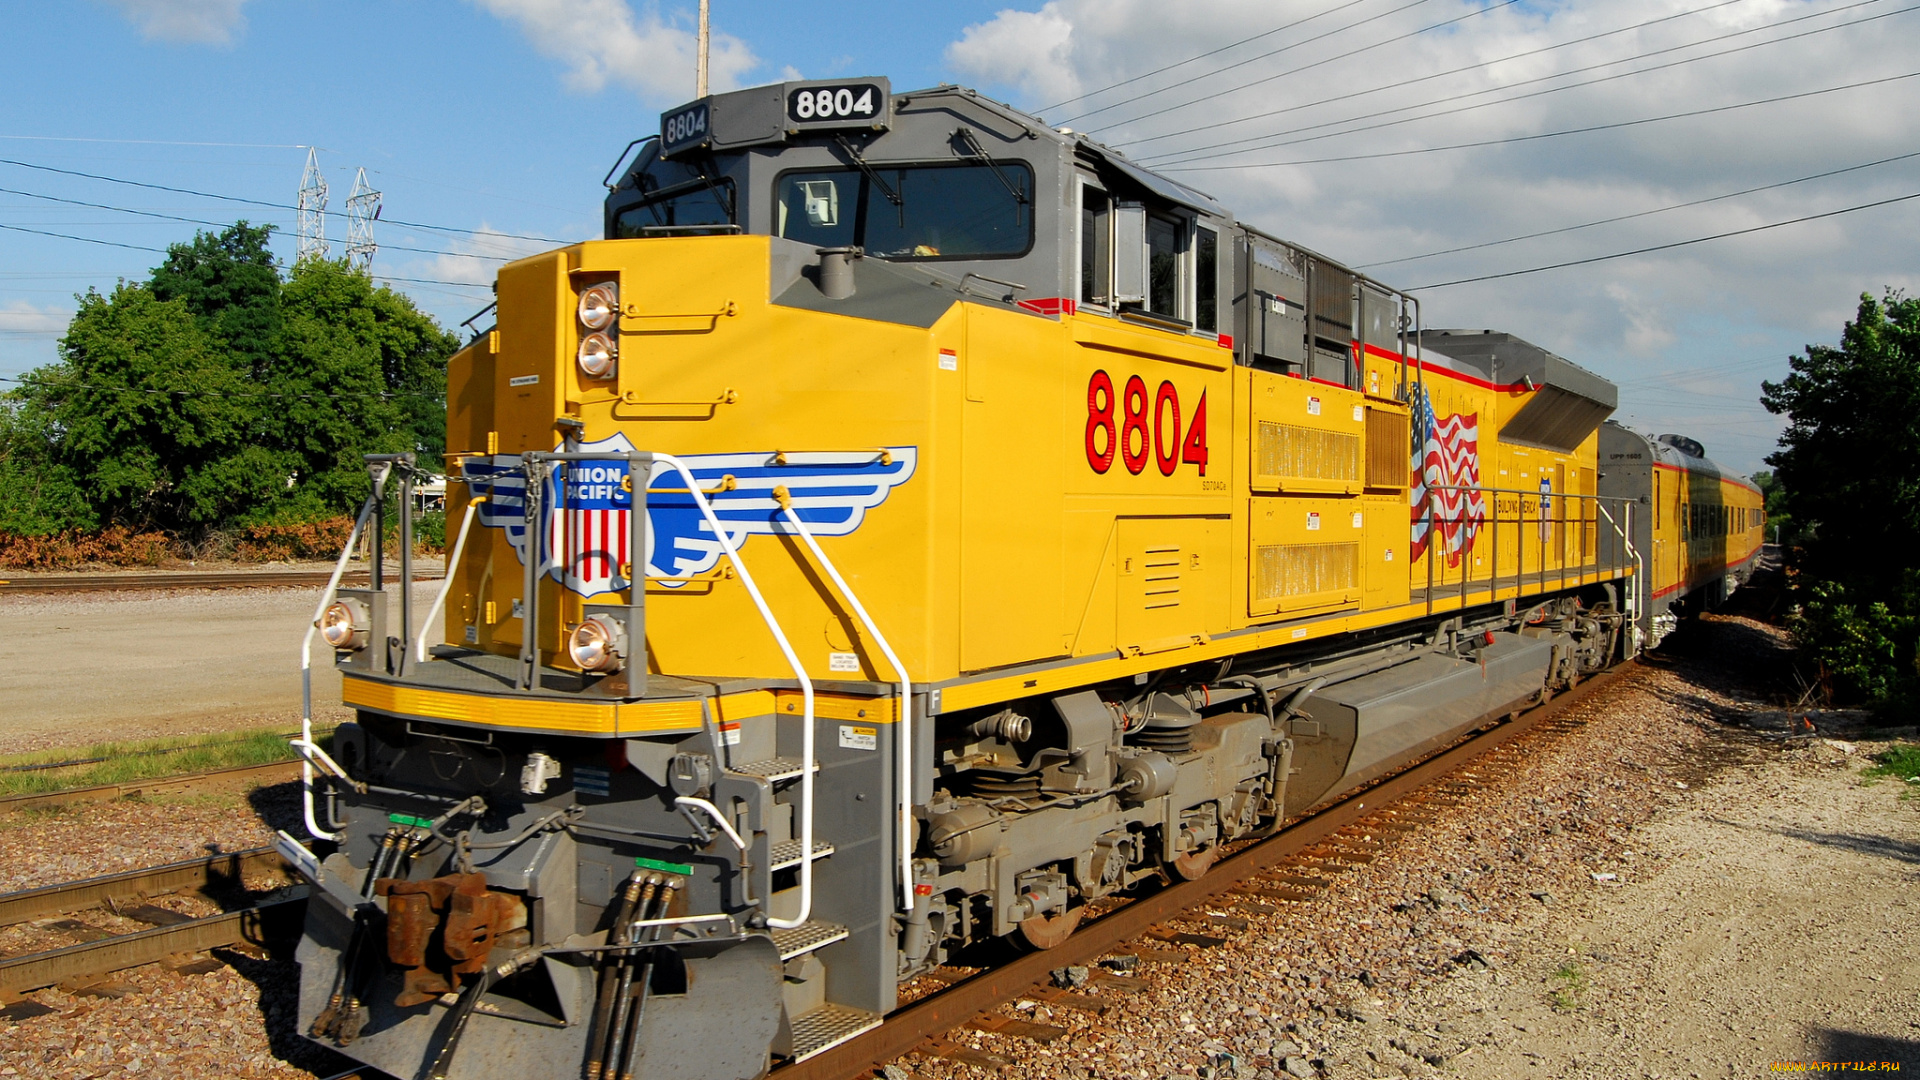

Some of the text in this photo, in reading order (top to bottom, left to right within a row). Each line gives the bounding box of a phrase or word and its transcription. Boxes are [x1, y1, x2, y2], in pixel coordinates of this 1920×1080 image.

[797, 88, 874, 119] 8804
[666, 106, 706, 144] 8804
[1085, 369, 1208, 477] 8804
[568, 467, 621, 483] UNION
[566, 485, 624, 500] PACIFIC
[932, 690, 940, 709] F
